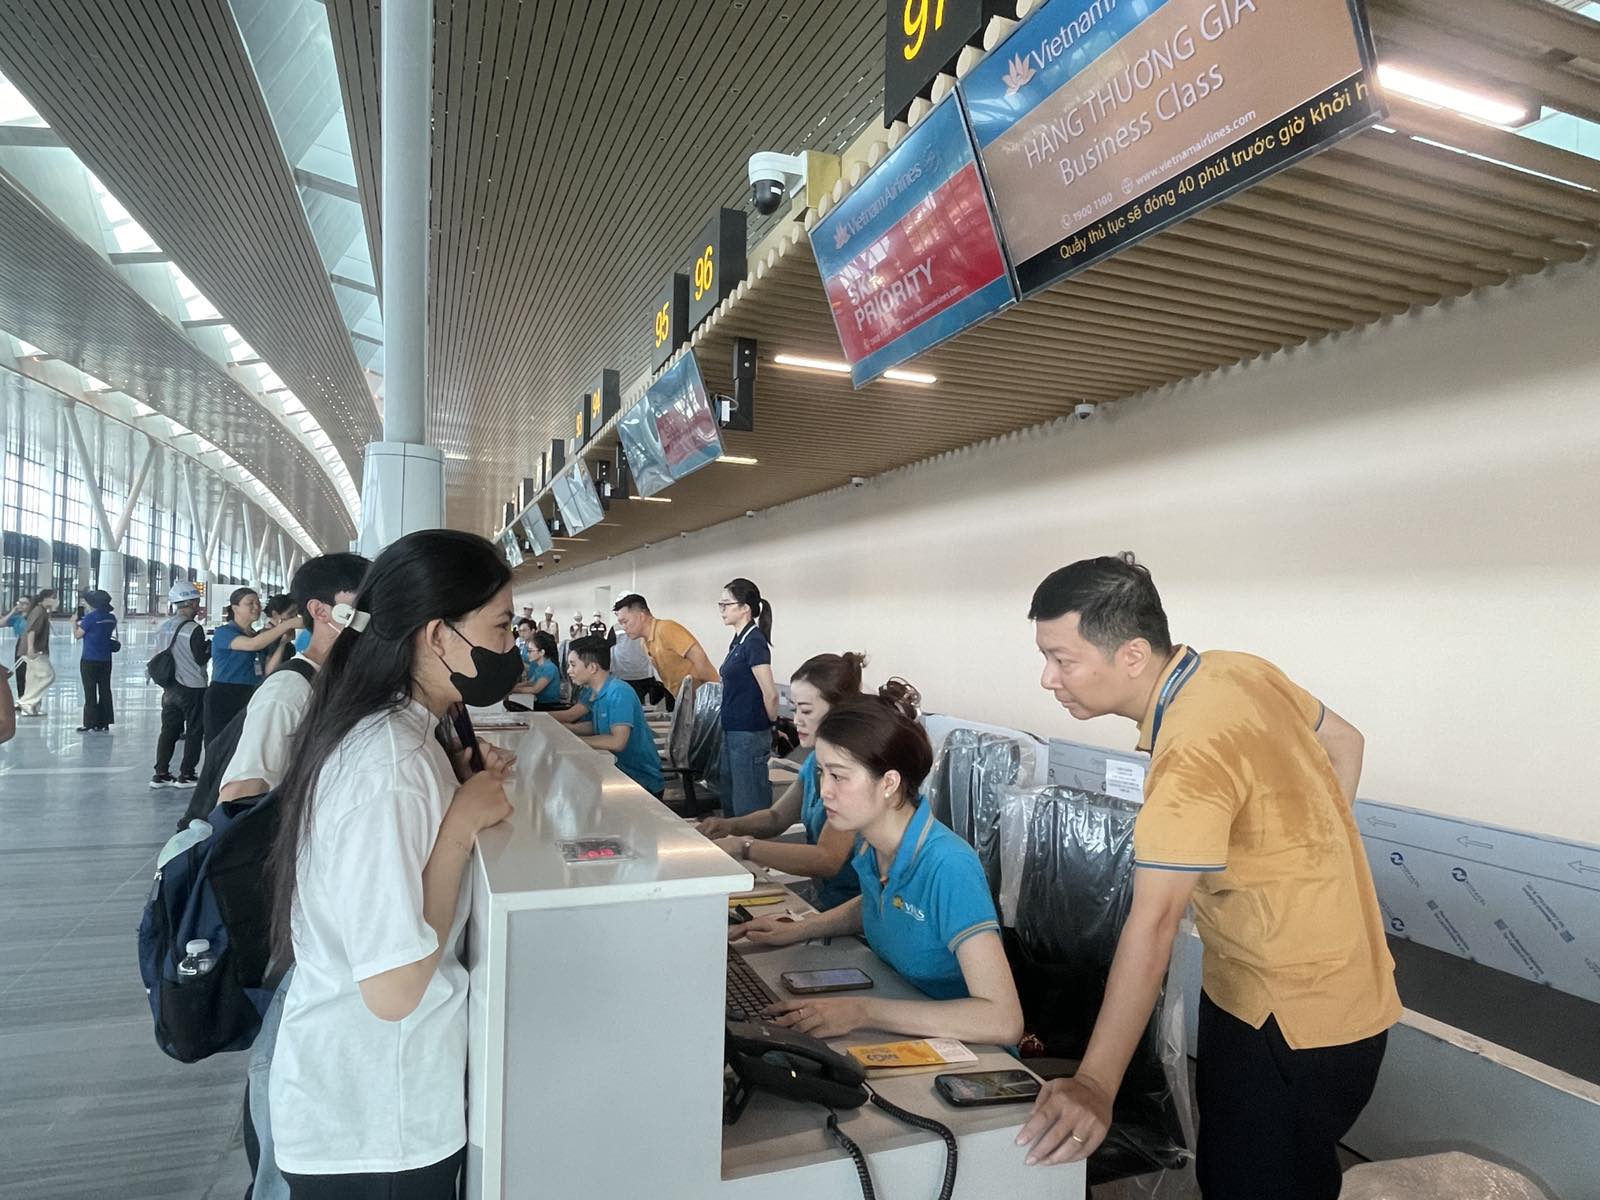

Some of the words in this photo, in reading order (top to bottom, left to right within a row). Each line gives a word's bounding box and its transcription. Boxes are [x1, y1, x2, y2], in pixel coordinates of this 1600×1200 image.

[1024, 107, 1085, 169] HẠNG
[1084, 24, 1196, 124] THƯƠNG
[1059, 111, 1152, 186] Business
[1156, 64, 1224, 121] Class
[1088, 224, 1106, 245] thủ
[1107, 216, 1126, 235] tục
[1127, 205, 1142, 224] sẽ
[1144, 189, 1176, 214] đóng
[1178, 175, 1195, 195] 40
[1198, 157, 1230, 189] phút
[1231, 135, 1275, 167] trước
[1279, 116, 1305, 146] giờ
[1310, 88, 1352, 126] khởi
[1135, 109, 1257, 186] www.vietnamairlines.com
[1073, 206, 1092, 220] 1900
[694, 245, 713, 301] 96
[854, 257, 933, 332] PRIORITY
[655, 301, 669, 348] 95
